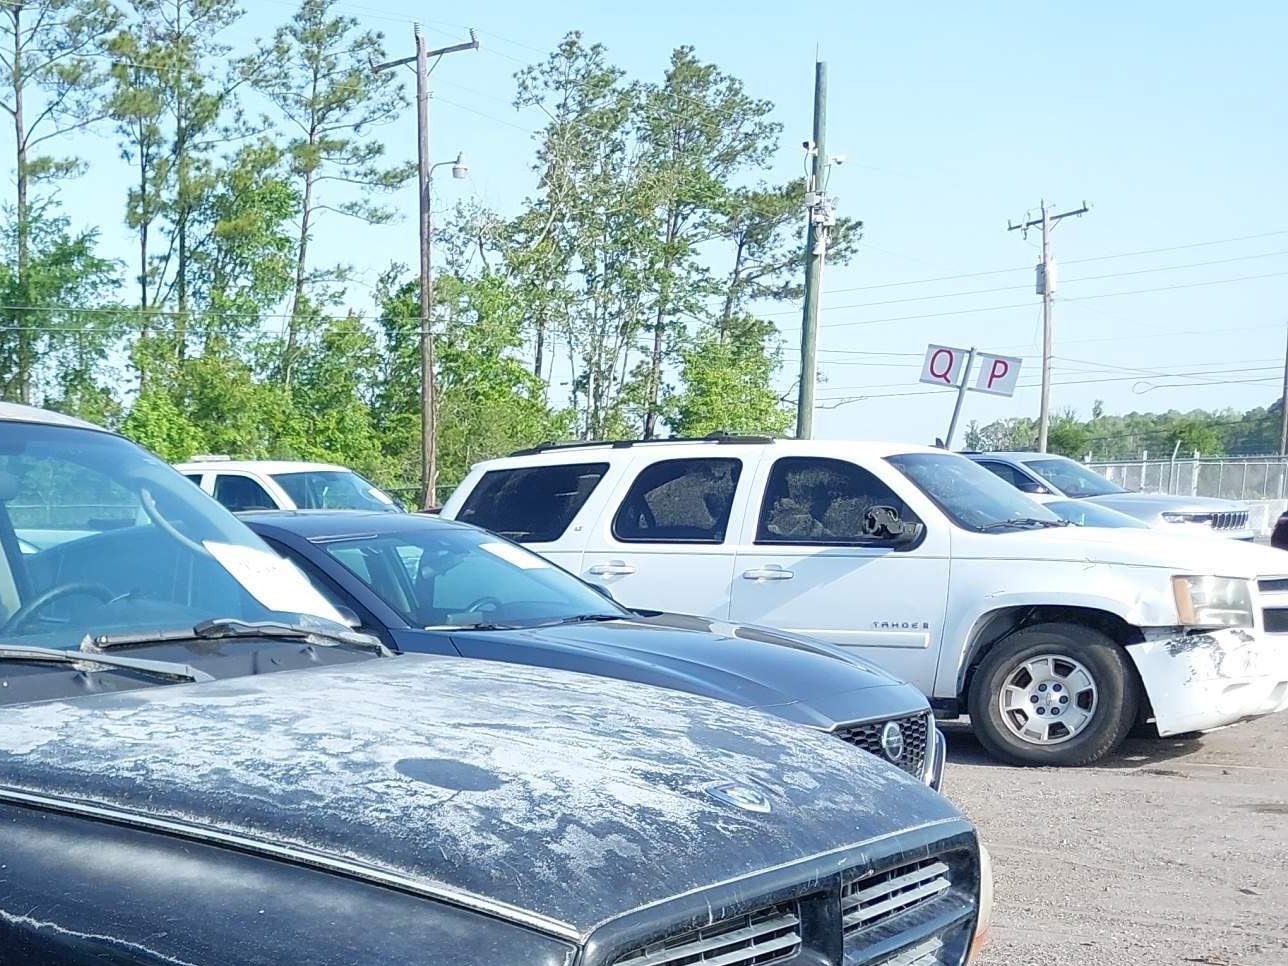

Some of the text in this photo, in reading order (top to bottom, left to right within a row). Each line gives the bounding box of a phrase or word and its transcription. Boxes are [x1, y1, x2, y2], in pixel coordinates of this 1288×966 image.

[929, 348, 1009, 389] Q P
[872, 621, 920, 630] TAHOE
